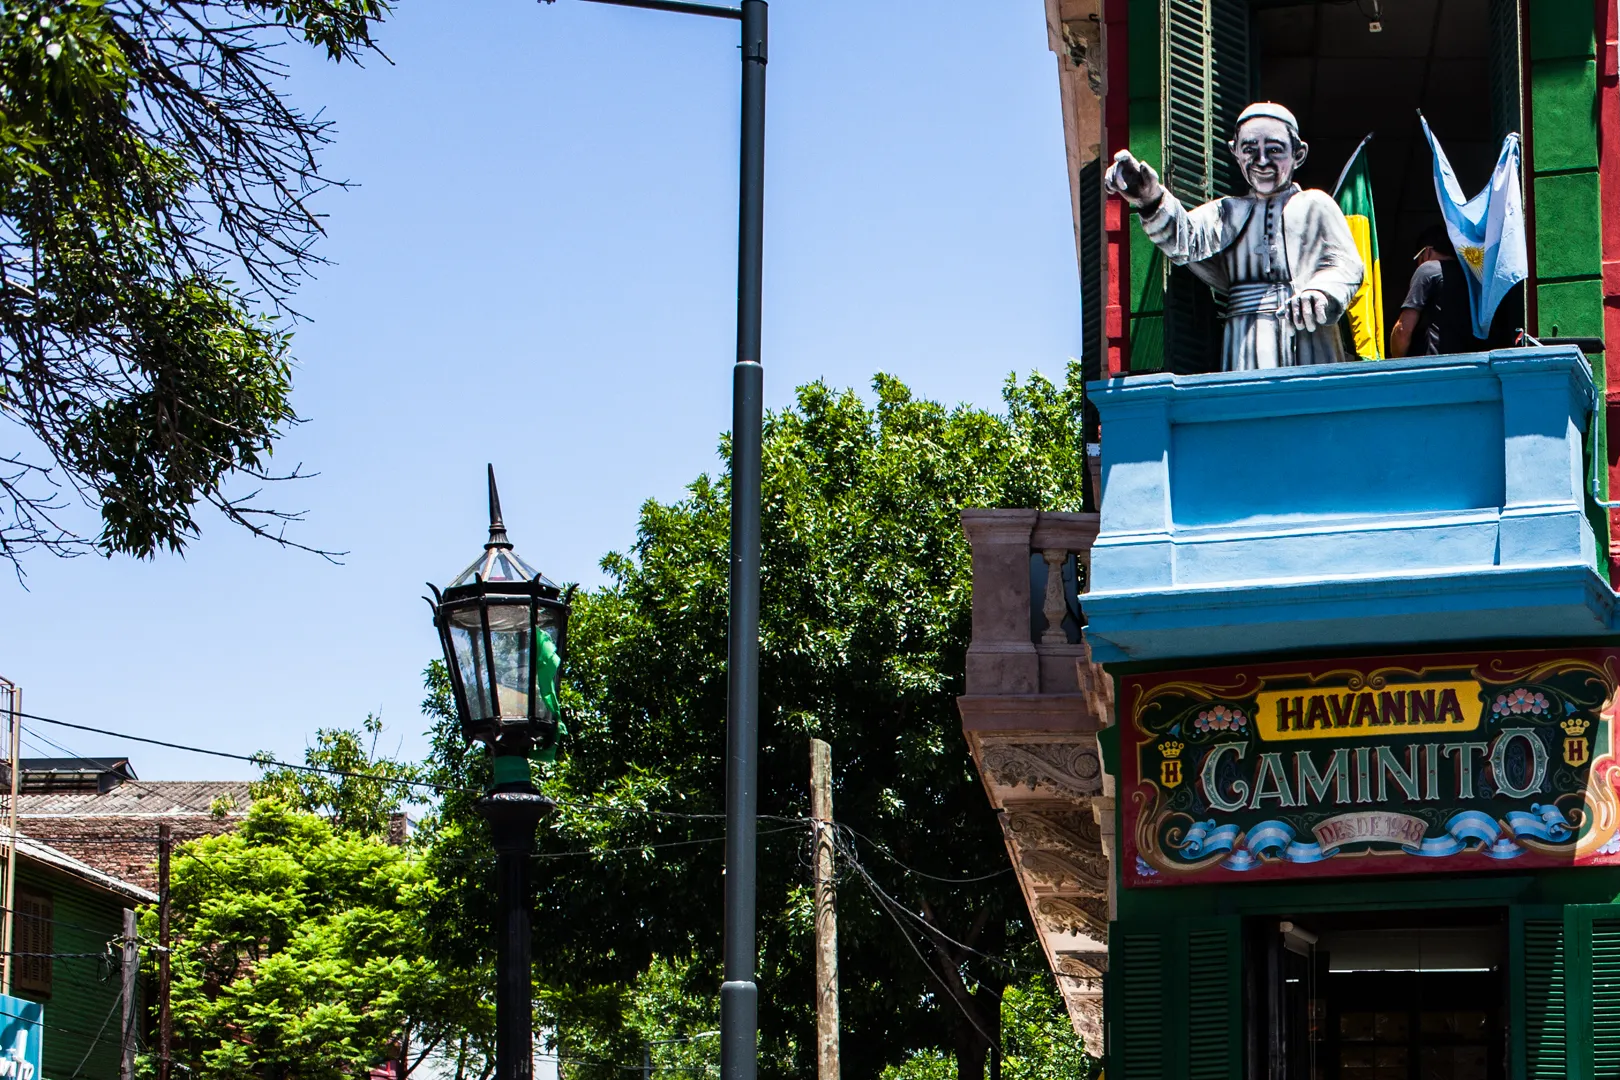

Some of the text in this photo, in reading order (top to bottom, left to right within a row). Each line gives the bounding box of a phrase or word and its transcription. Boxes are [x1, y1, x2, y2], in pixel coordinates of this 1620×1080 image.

[1277, 688, 1464, 732] HAVANNA
[1568, 740, 1584, 761] H
[1165, 762, 1180, 783] H
[1199, 727, 1550, 812] CAMINITO
[1319, 816, 1424, 846] DESDE 1948
